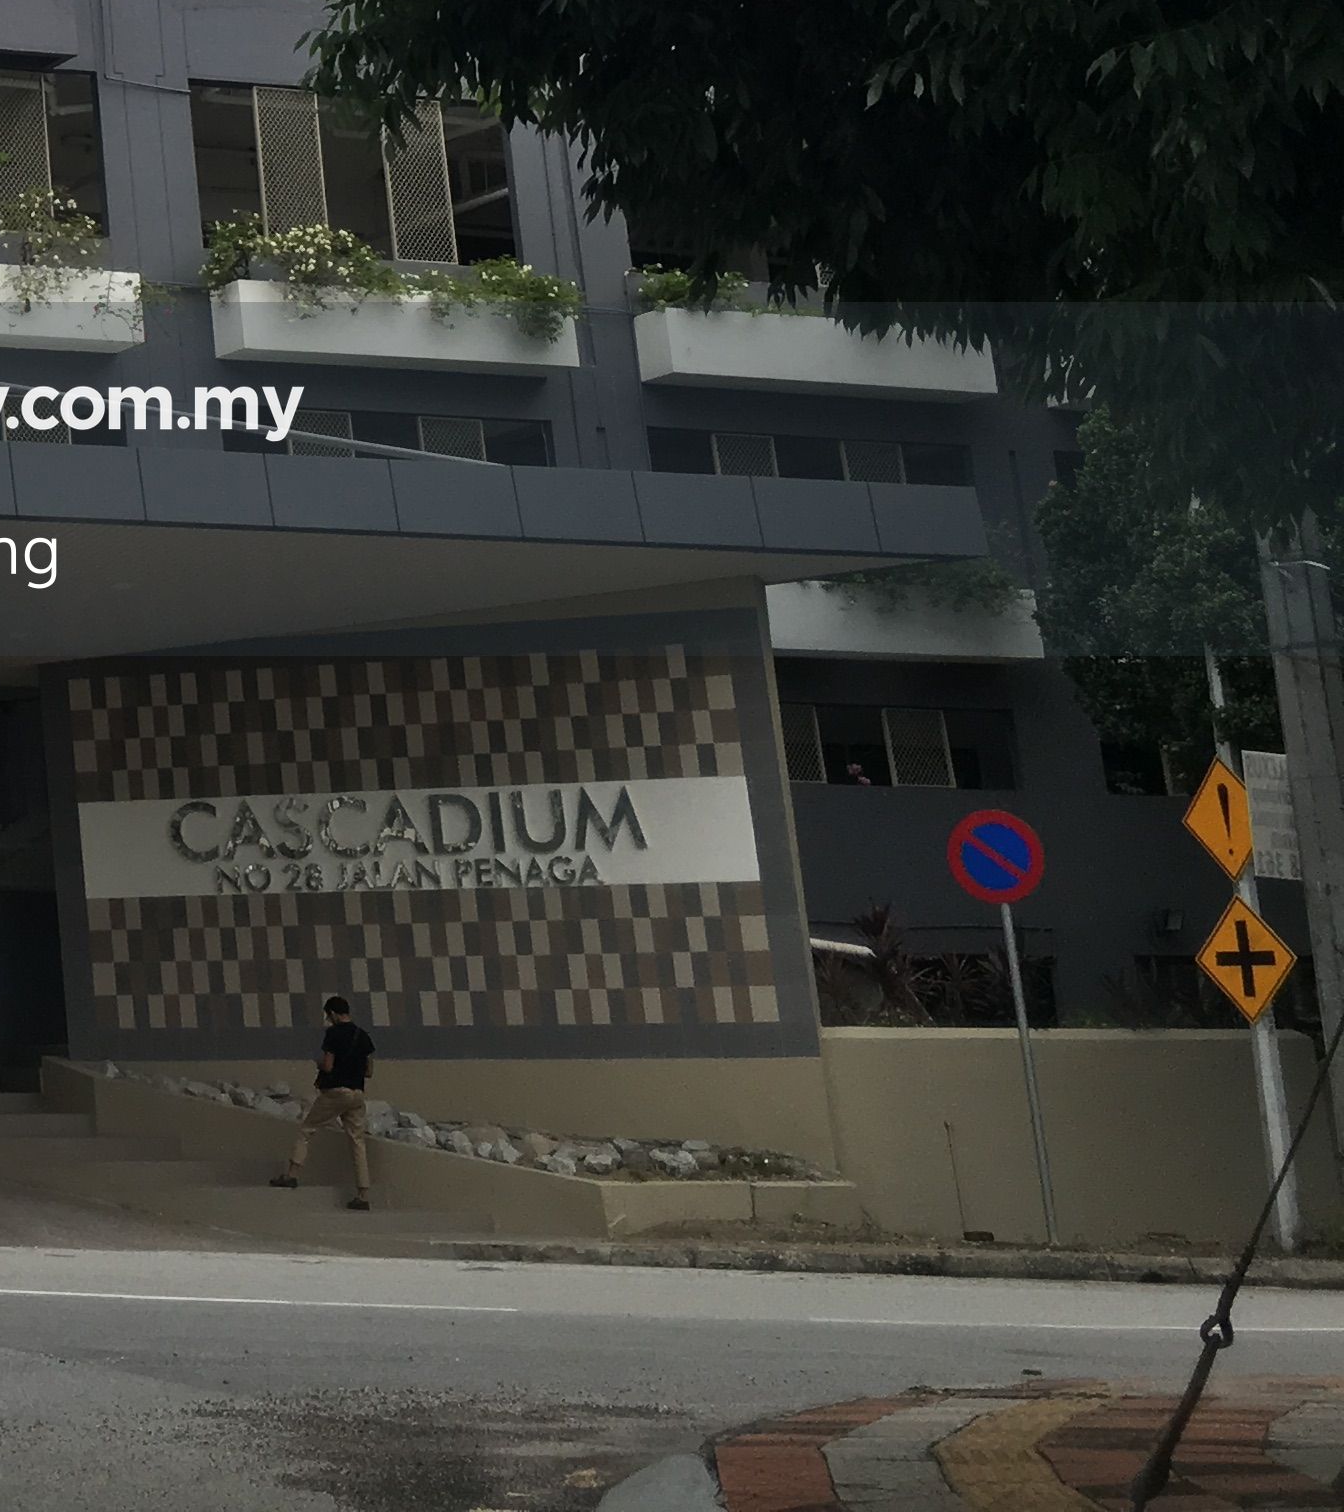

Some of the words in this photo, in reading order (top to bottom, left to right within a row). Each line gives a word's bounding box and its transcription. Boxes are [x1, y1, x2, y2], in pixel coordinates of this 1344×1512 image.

[169, 785, 648, 863] CASCADIUM
[215, 862, 272, 893] NO
[282, 862, 323, 891] 28
[337, 859, 442, 890] JALAN
[454, 855, 604, 888] PENAGA
